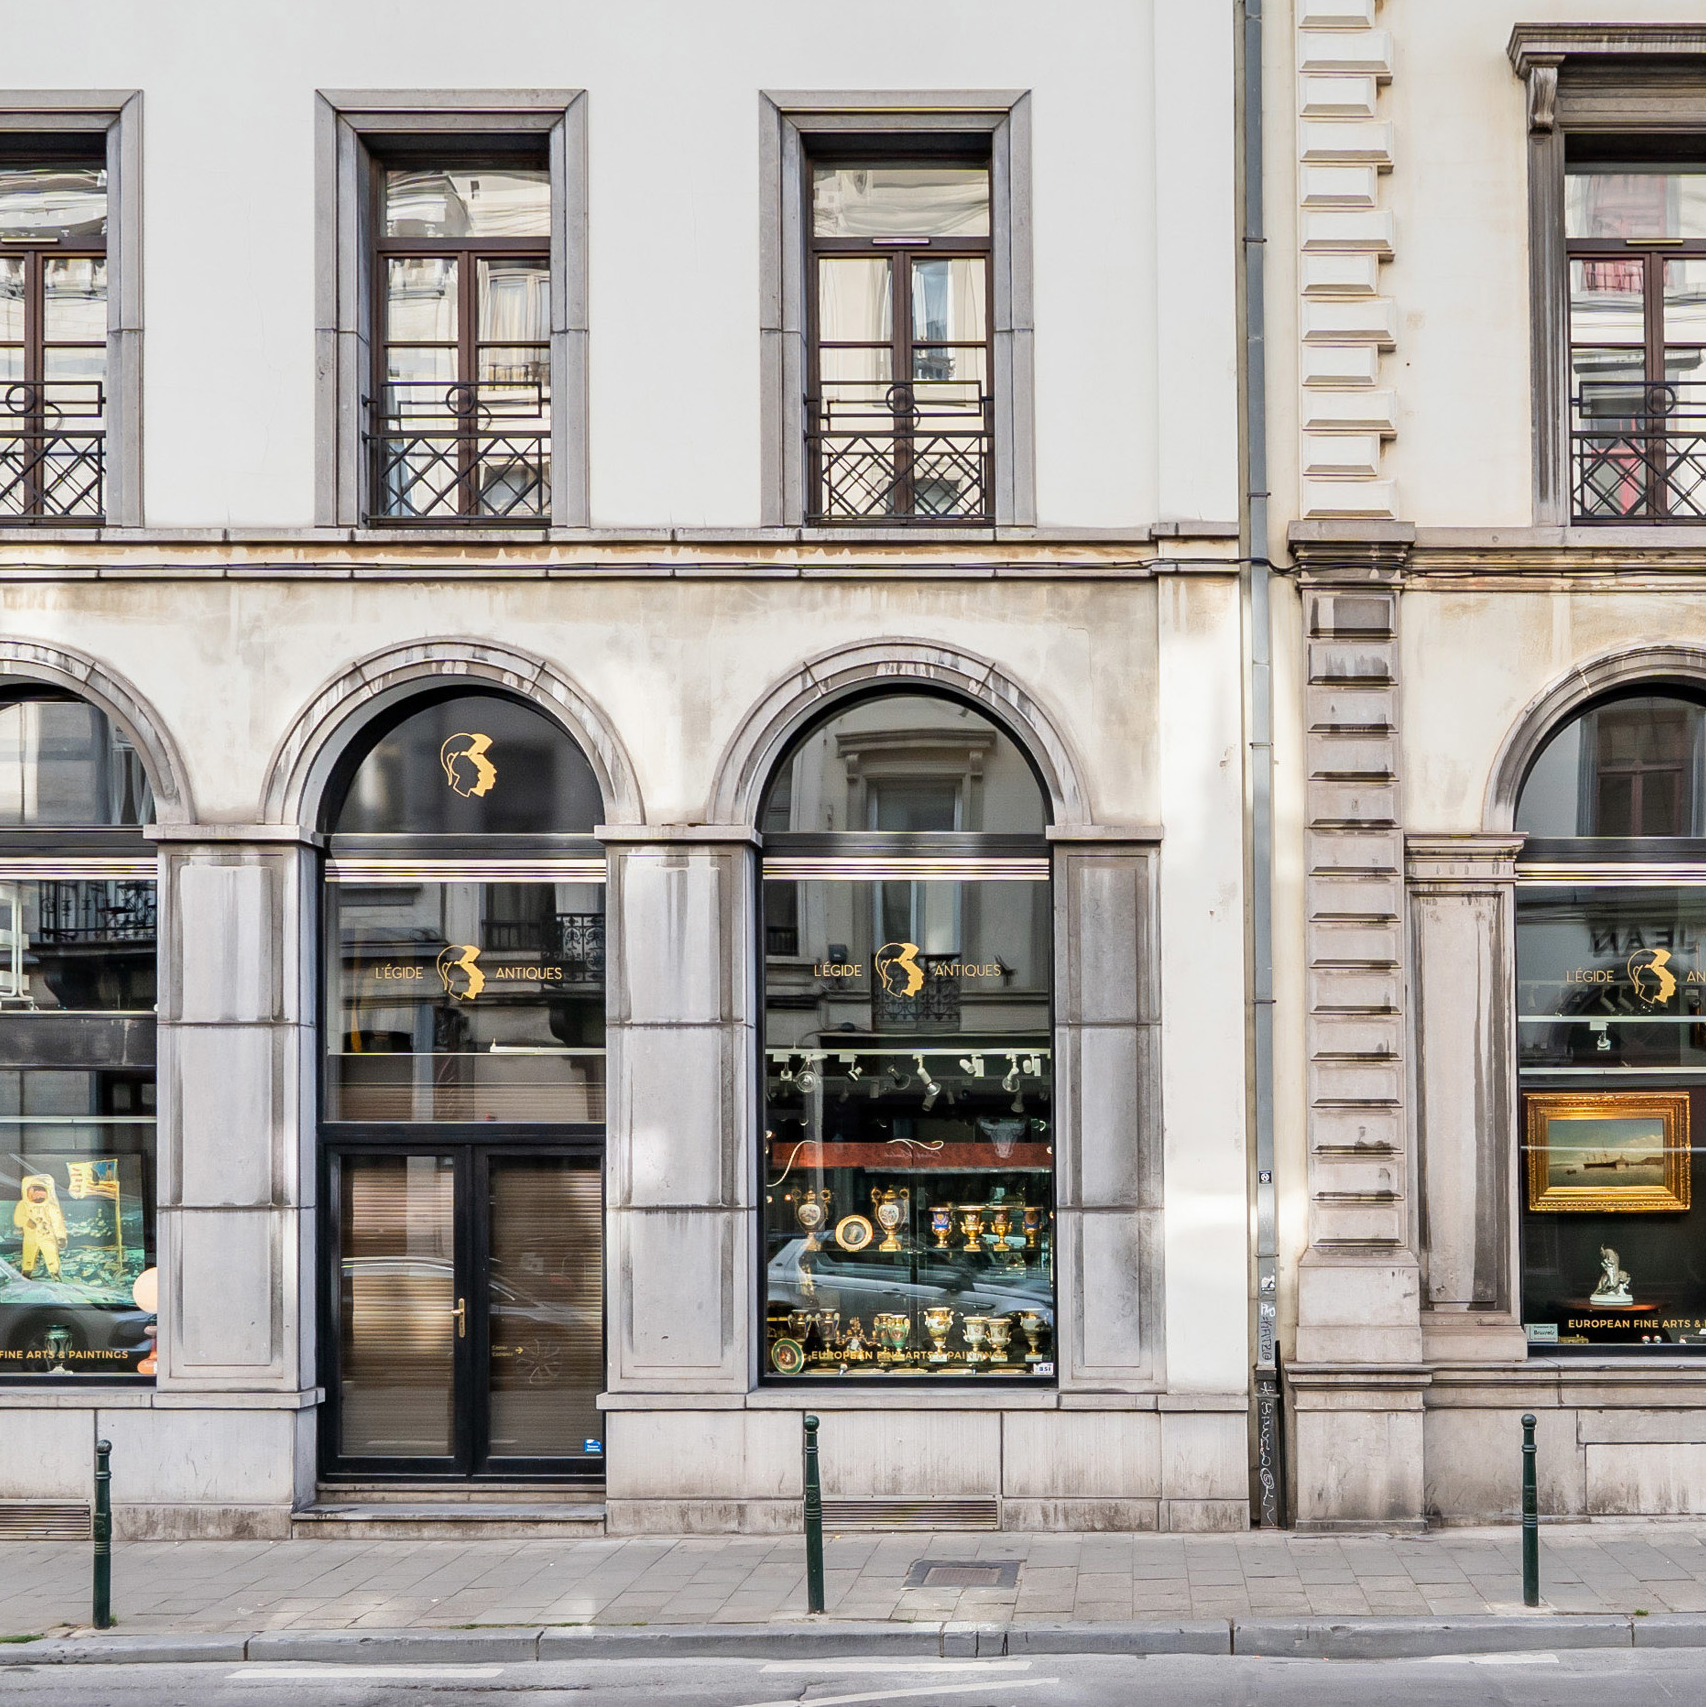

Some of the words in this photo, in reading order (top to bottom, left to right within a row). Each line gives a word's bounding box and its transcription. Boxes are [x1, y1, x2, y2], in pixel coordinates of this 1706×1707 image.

[375, 963, 424, 980] L'ÉGIDE
[495, 967, 563, 980] ANTIQUES
[813, 961, 862, 977] L'ÉGIDE
[934, 964, 1002, 977] ANTIQUES
[1566, 967, 1614, 983] L'ÉGIDE
[1568, 1319, 1629, 1328] EUROPEAN
[1633, 1319, 1659, 1328] FINE
[1662, 1319, 1691, 1328] ARTS
[26, 1350, 55, 1359] ARTS
[68, 1350, 129, 1359] PAINTINGS
[811, 1350, 873, 1360] EUROPEAN
[906, 1350, 932, 1360] ARTS
